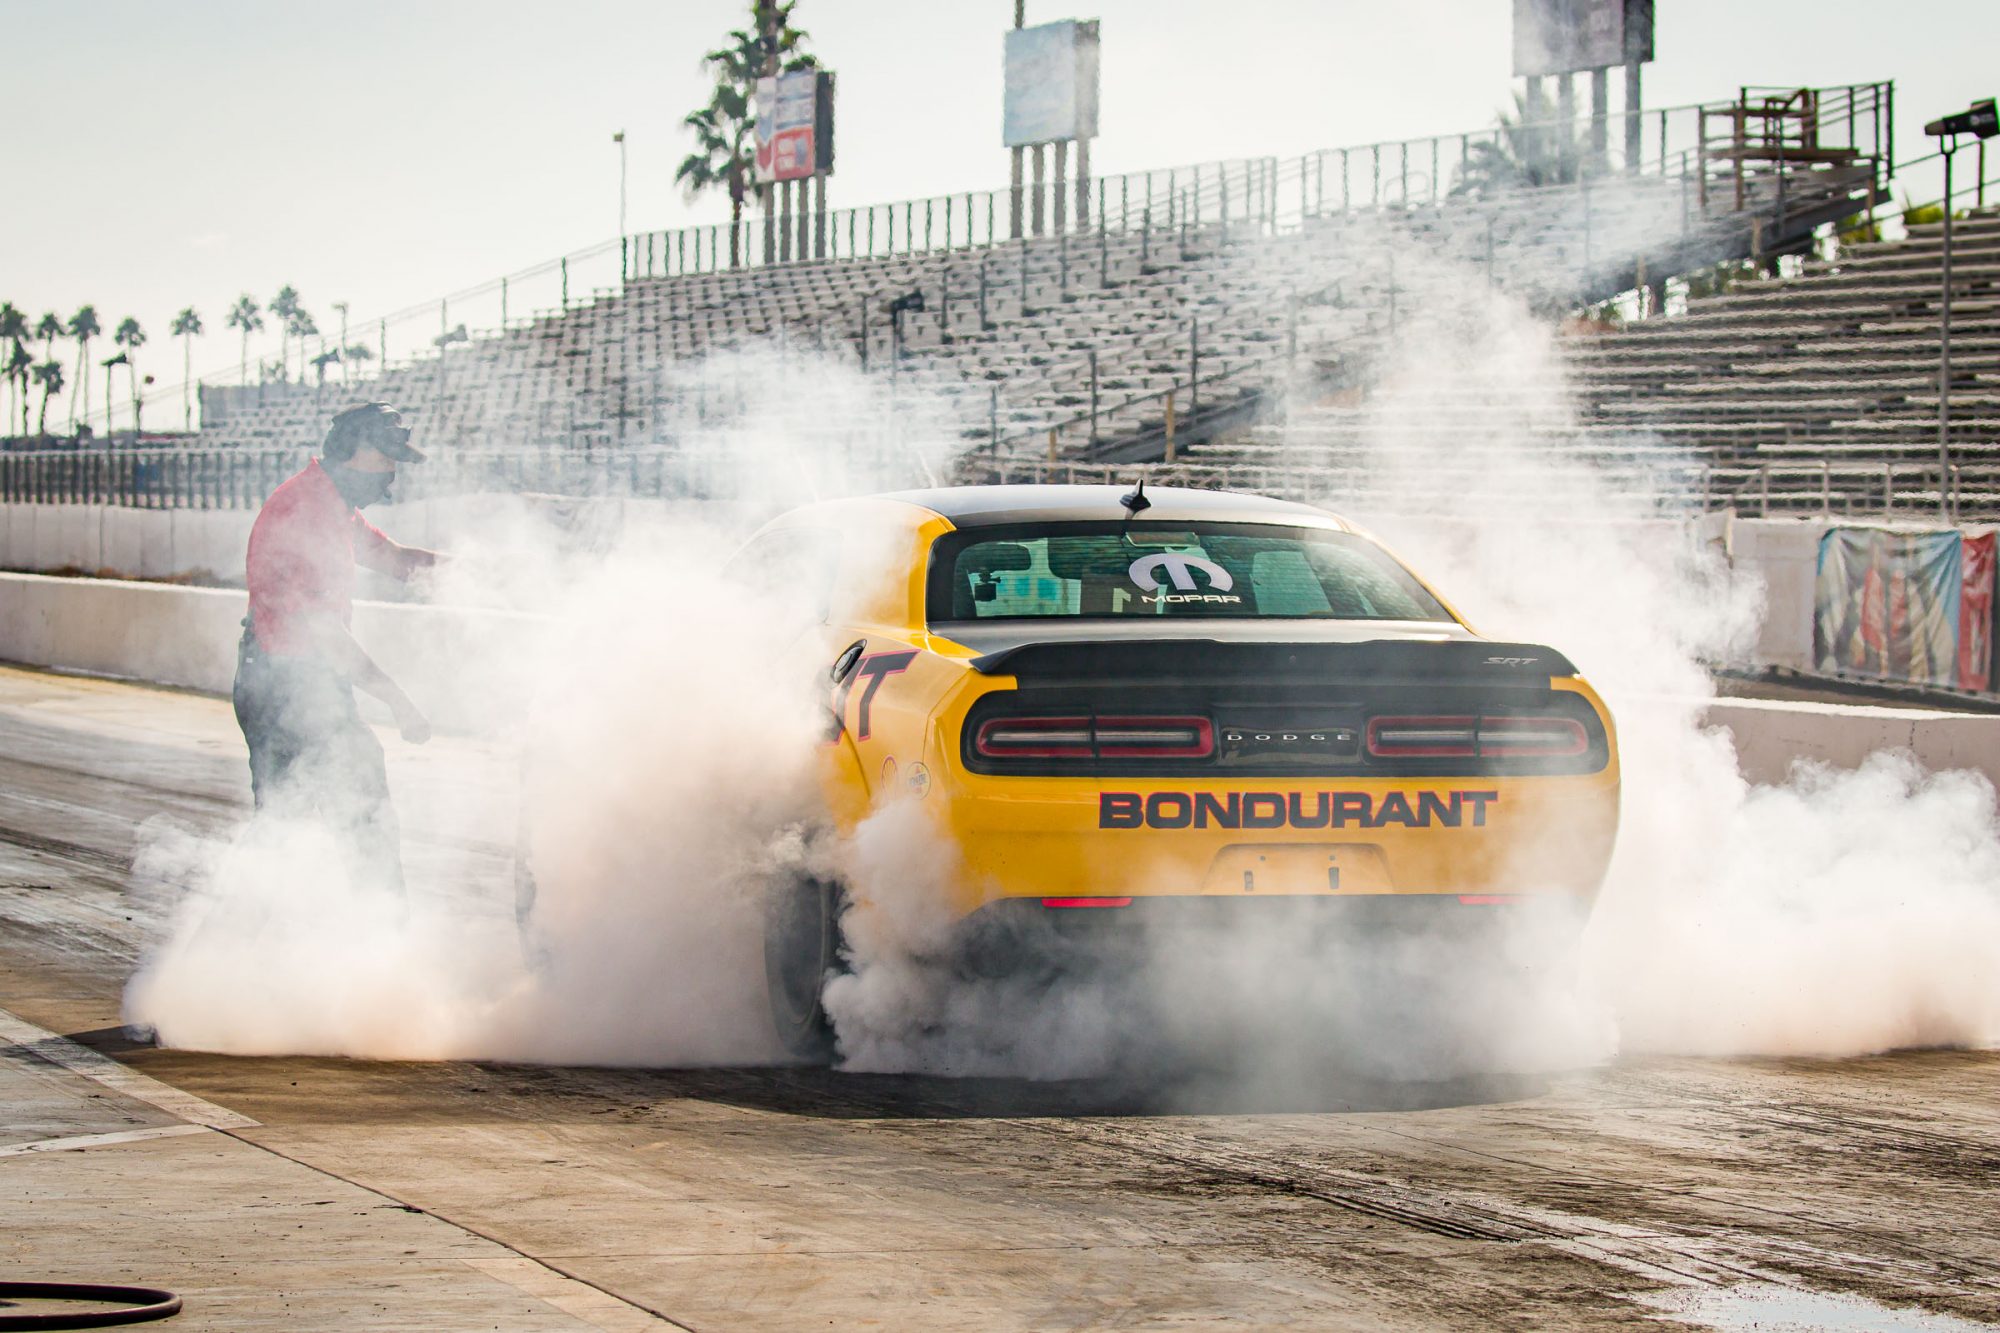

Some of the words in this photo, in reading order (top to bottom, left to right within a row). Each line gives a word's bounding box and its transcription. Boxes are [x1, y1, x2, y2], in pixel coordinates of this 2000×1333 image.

[1141, 594, 1242, 604] MOPAR
[1482, 656, 1539, 668] SRT
[1226, 733, 1352, 742] DODGE
[1099, 791, 1499, 829] BONDURANT
